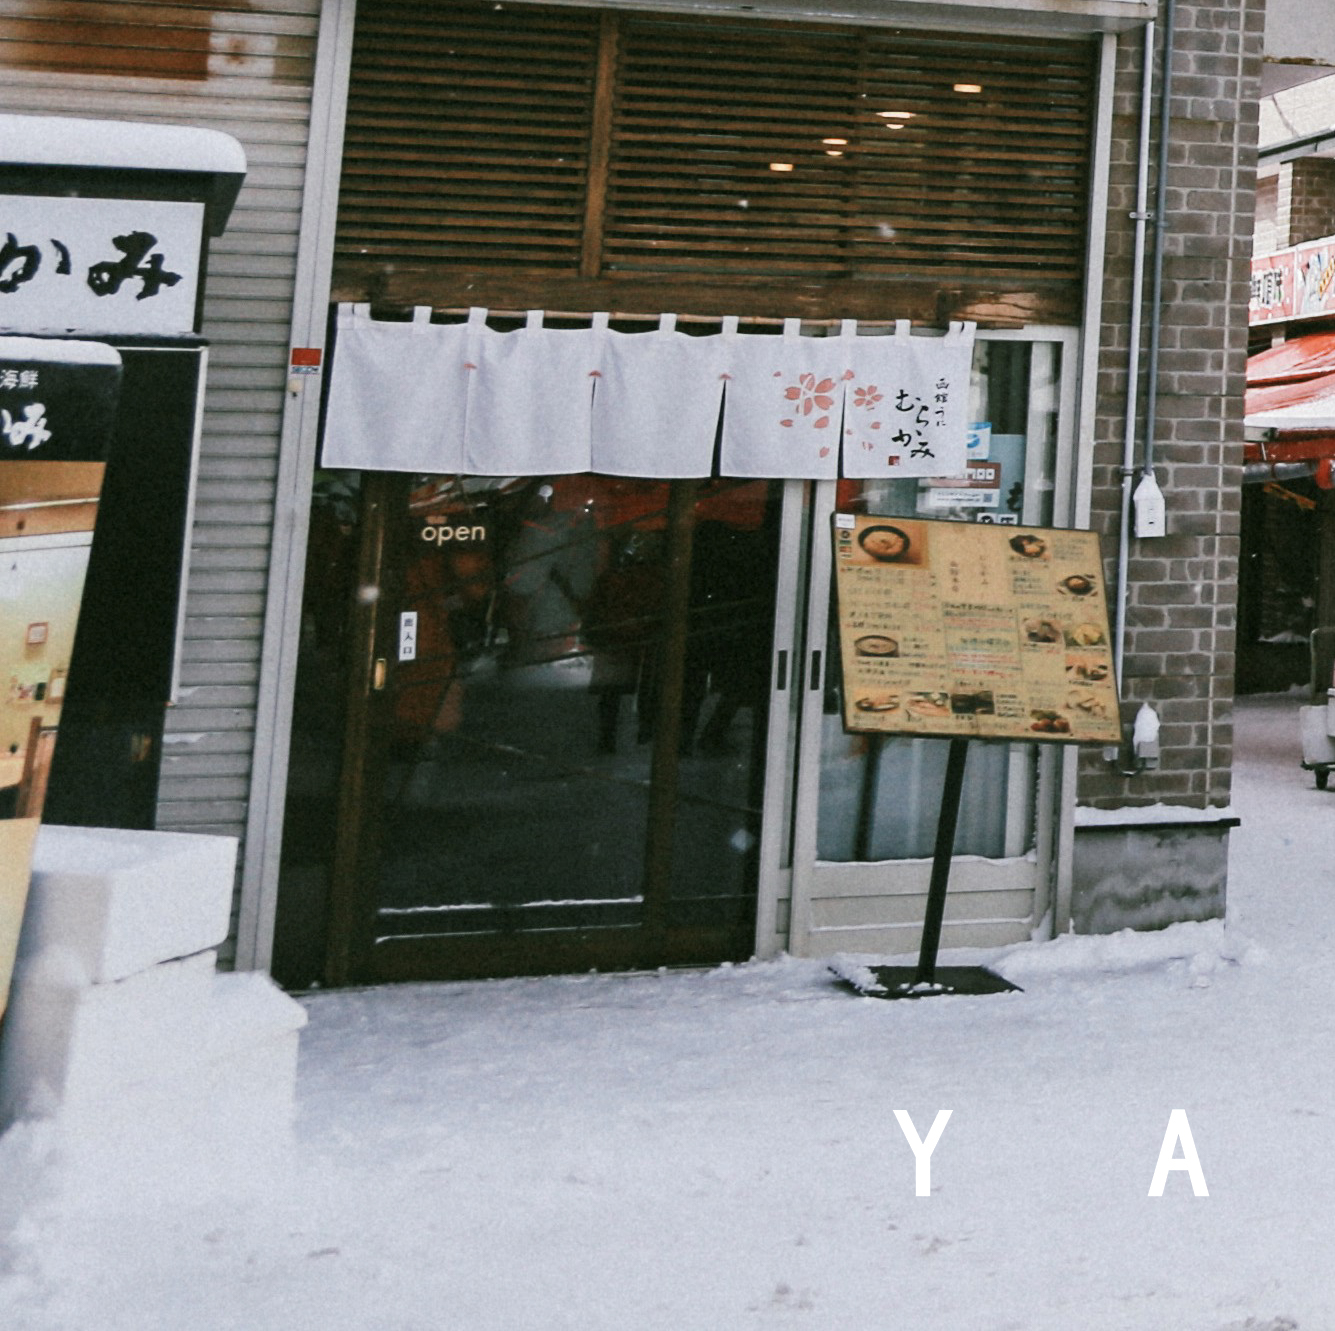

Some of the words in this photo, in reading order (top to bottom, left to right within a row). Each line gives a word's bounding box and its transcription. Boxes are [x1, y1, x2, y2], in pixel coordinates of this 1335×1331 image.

[891, 388, 935, 459] むらかみ
[934, 377, 950, 427] 函館うに
[420, 525, 487, 547] open
